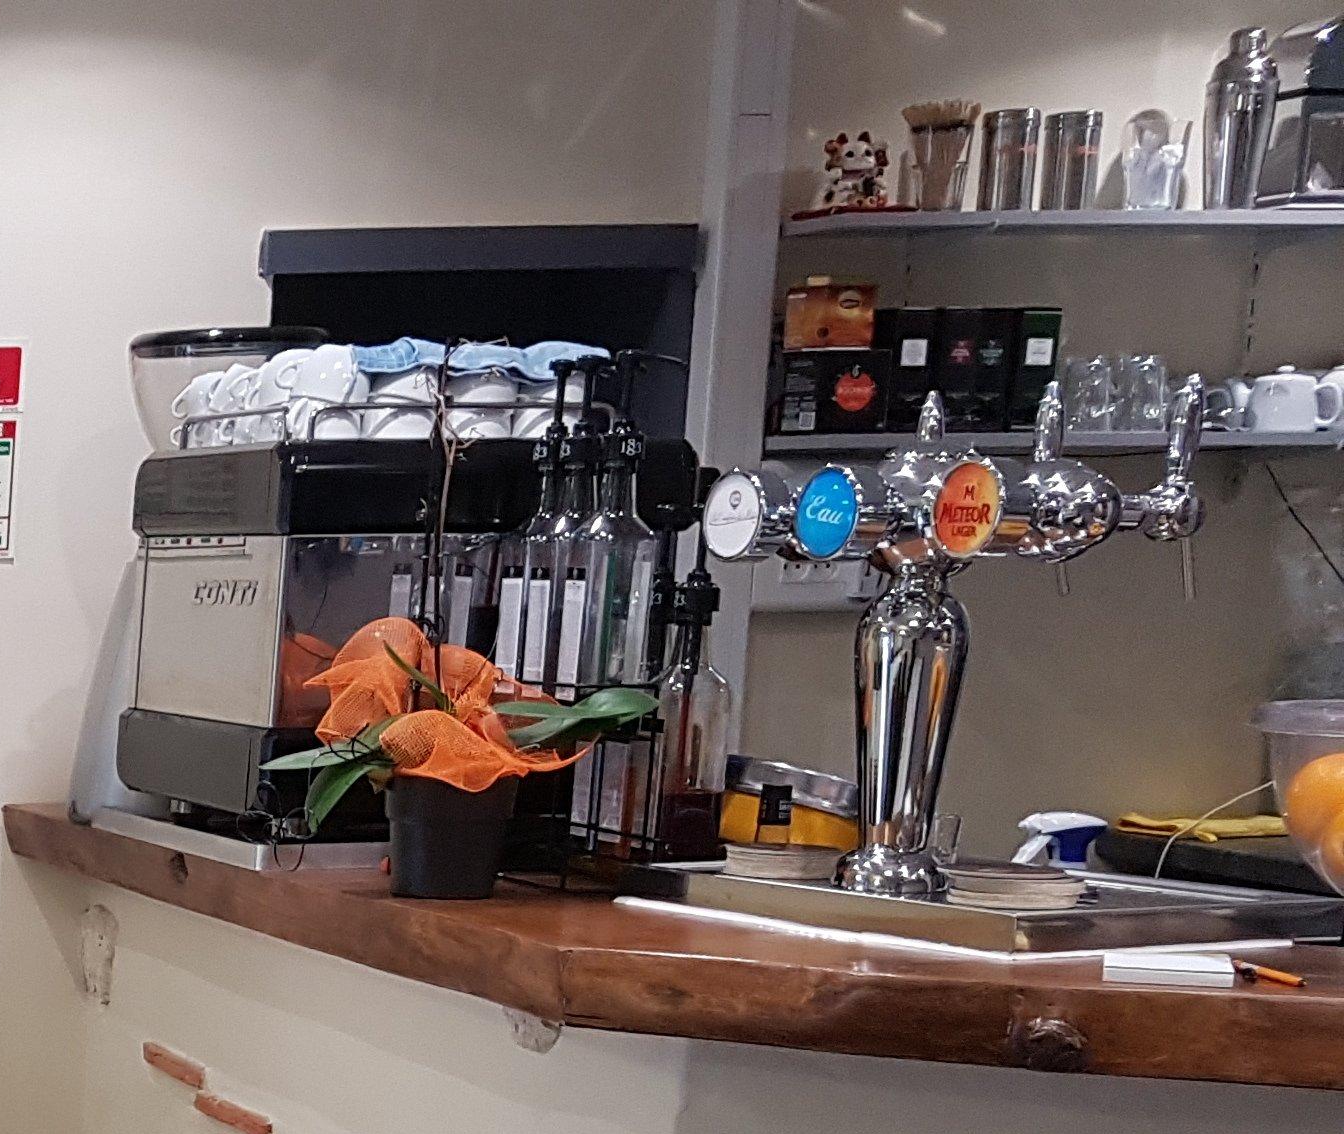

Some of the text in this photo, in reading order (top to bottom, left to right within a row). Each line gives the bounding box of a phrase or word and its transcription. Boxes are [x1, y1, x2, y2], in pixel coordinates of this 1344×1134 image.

[805, 494, 844, 525] Eau
[939, 502, 991, 524] METEOR
[193, 579, 259, 606] CONTI
